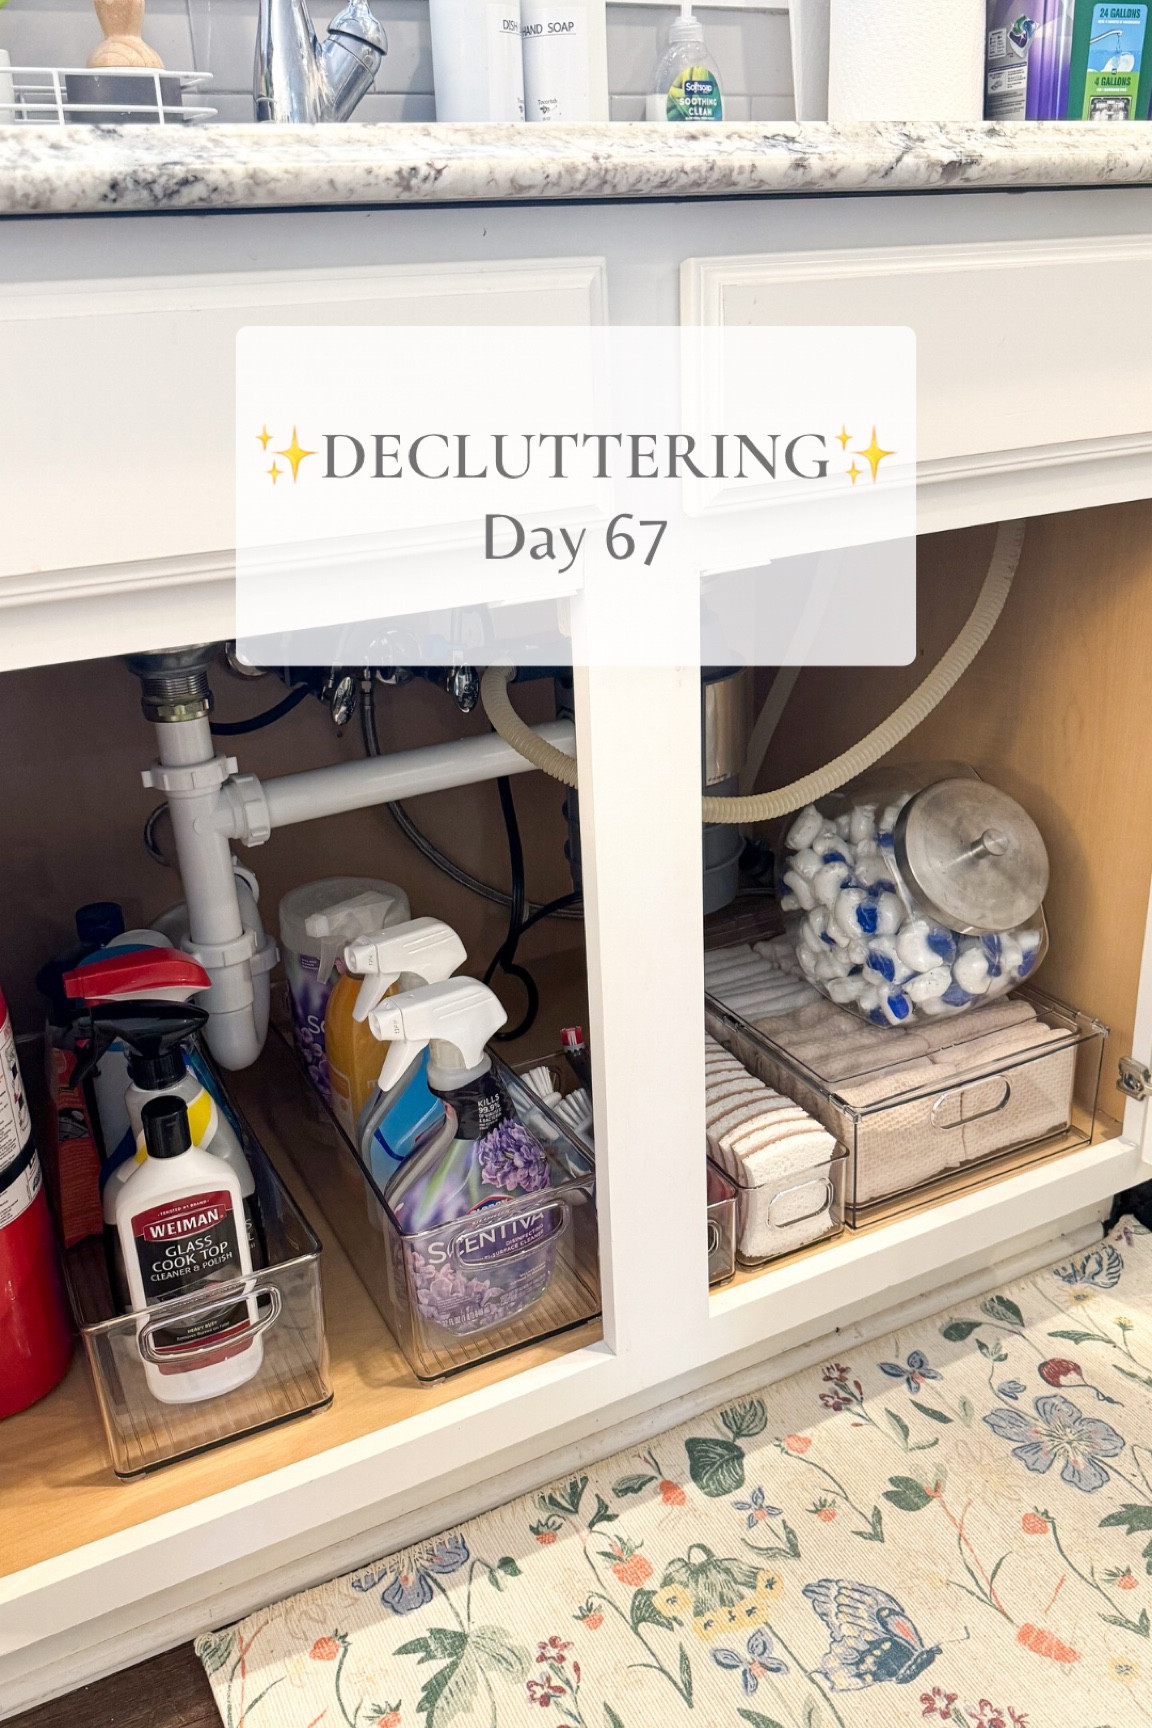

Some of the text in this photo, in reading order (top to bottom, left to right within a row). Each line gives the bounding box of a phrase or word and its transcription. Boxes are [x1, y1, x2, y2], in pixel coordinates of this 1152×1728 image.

[1100, 7, 1141, 19] 24 GALLONS
[503, 19, 518, 31] DISH
[522, 21, 575, 37] HAND SOAP
[1094, 77, 1131, 87] 4 GALLONS
[679, 97, 717, 107] SOOTHING
[688, 107, 713, 116] CLEAN
[477, 1093, 500, 1107] KILLS
[478, 1102, 501, 1114] 99.9%
[149, 1207, 219, 1239] WEIMAN
[506, 1223, 544, 1246] DISINFECTING
[519, 1229, 545, 1247] CLEANER
[165, 1234, 213, 1257] GLASS
[152, 1241, 229, 1273] COOK TOP
[150, 1251, 233, 1282] CLEANER & POLISH
